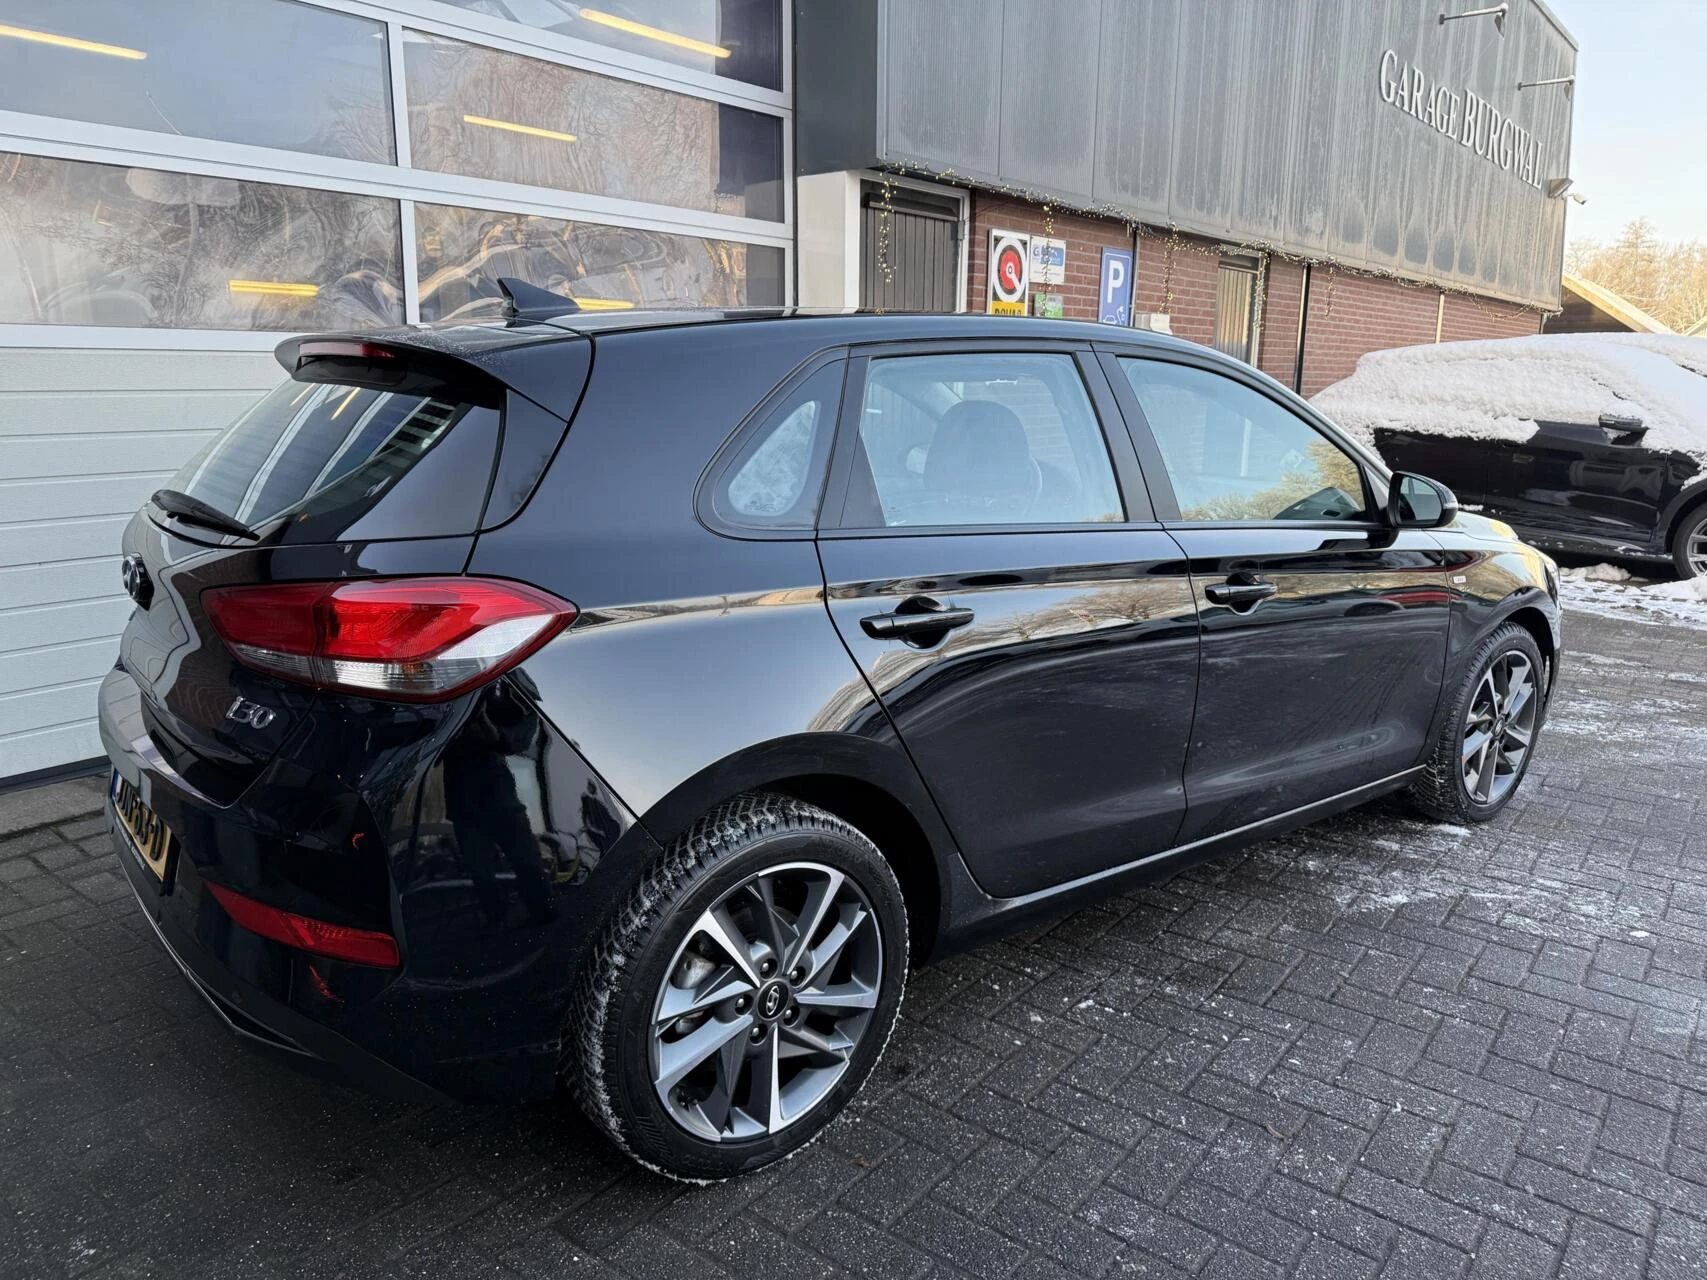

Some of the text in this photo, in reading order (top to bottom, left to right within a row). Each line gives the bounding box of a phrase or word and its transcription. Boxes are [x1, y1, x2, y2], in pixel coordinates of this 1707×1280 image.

[1379, 48, 1543, 190] GARAGE BURGWAL
[1106, 259, 1125, 304] P
